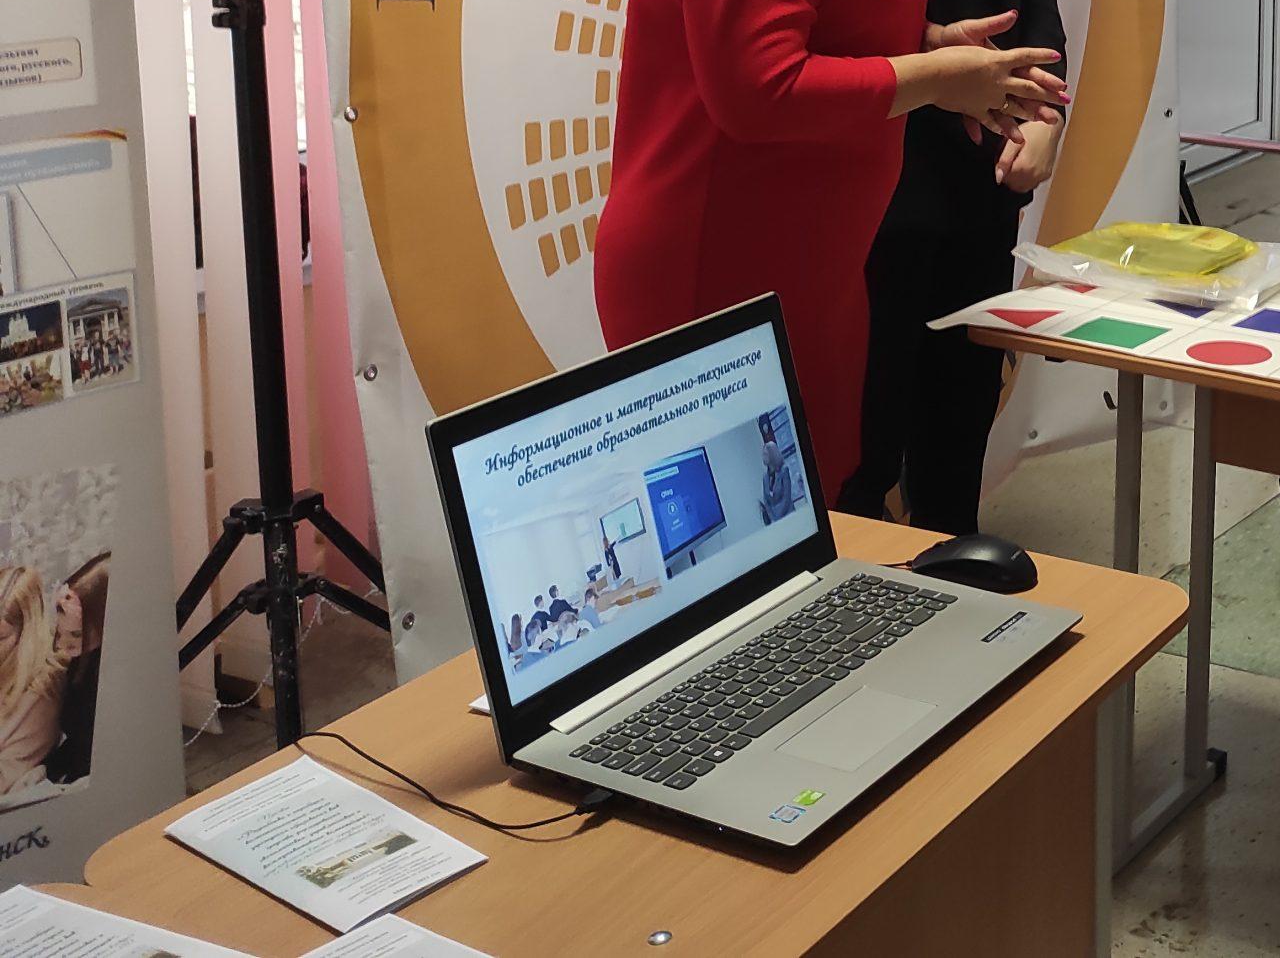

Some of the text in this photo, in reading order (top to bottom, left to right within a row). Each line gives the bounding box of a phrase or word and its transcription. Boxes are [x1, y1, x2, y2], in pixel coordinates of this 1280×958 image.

[485, 349, 762, 475] Информационное и материально-техническое
[517, 377, 748, 488] обеспечение образовательного процесса
